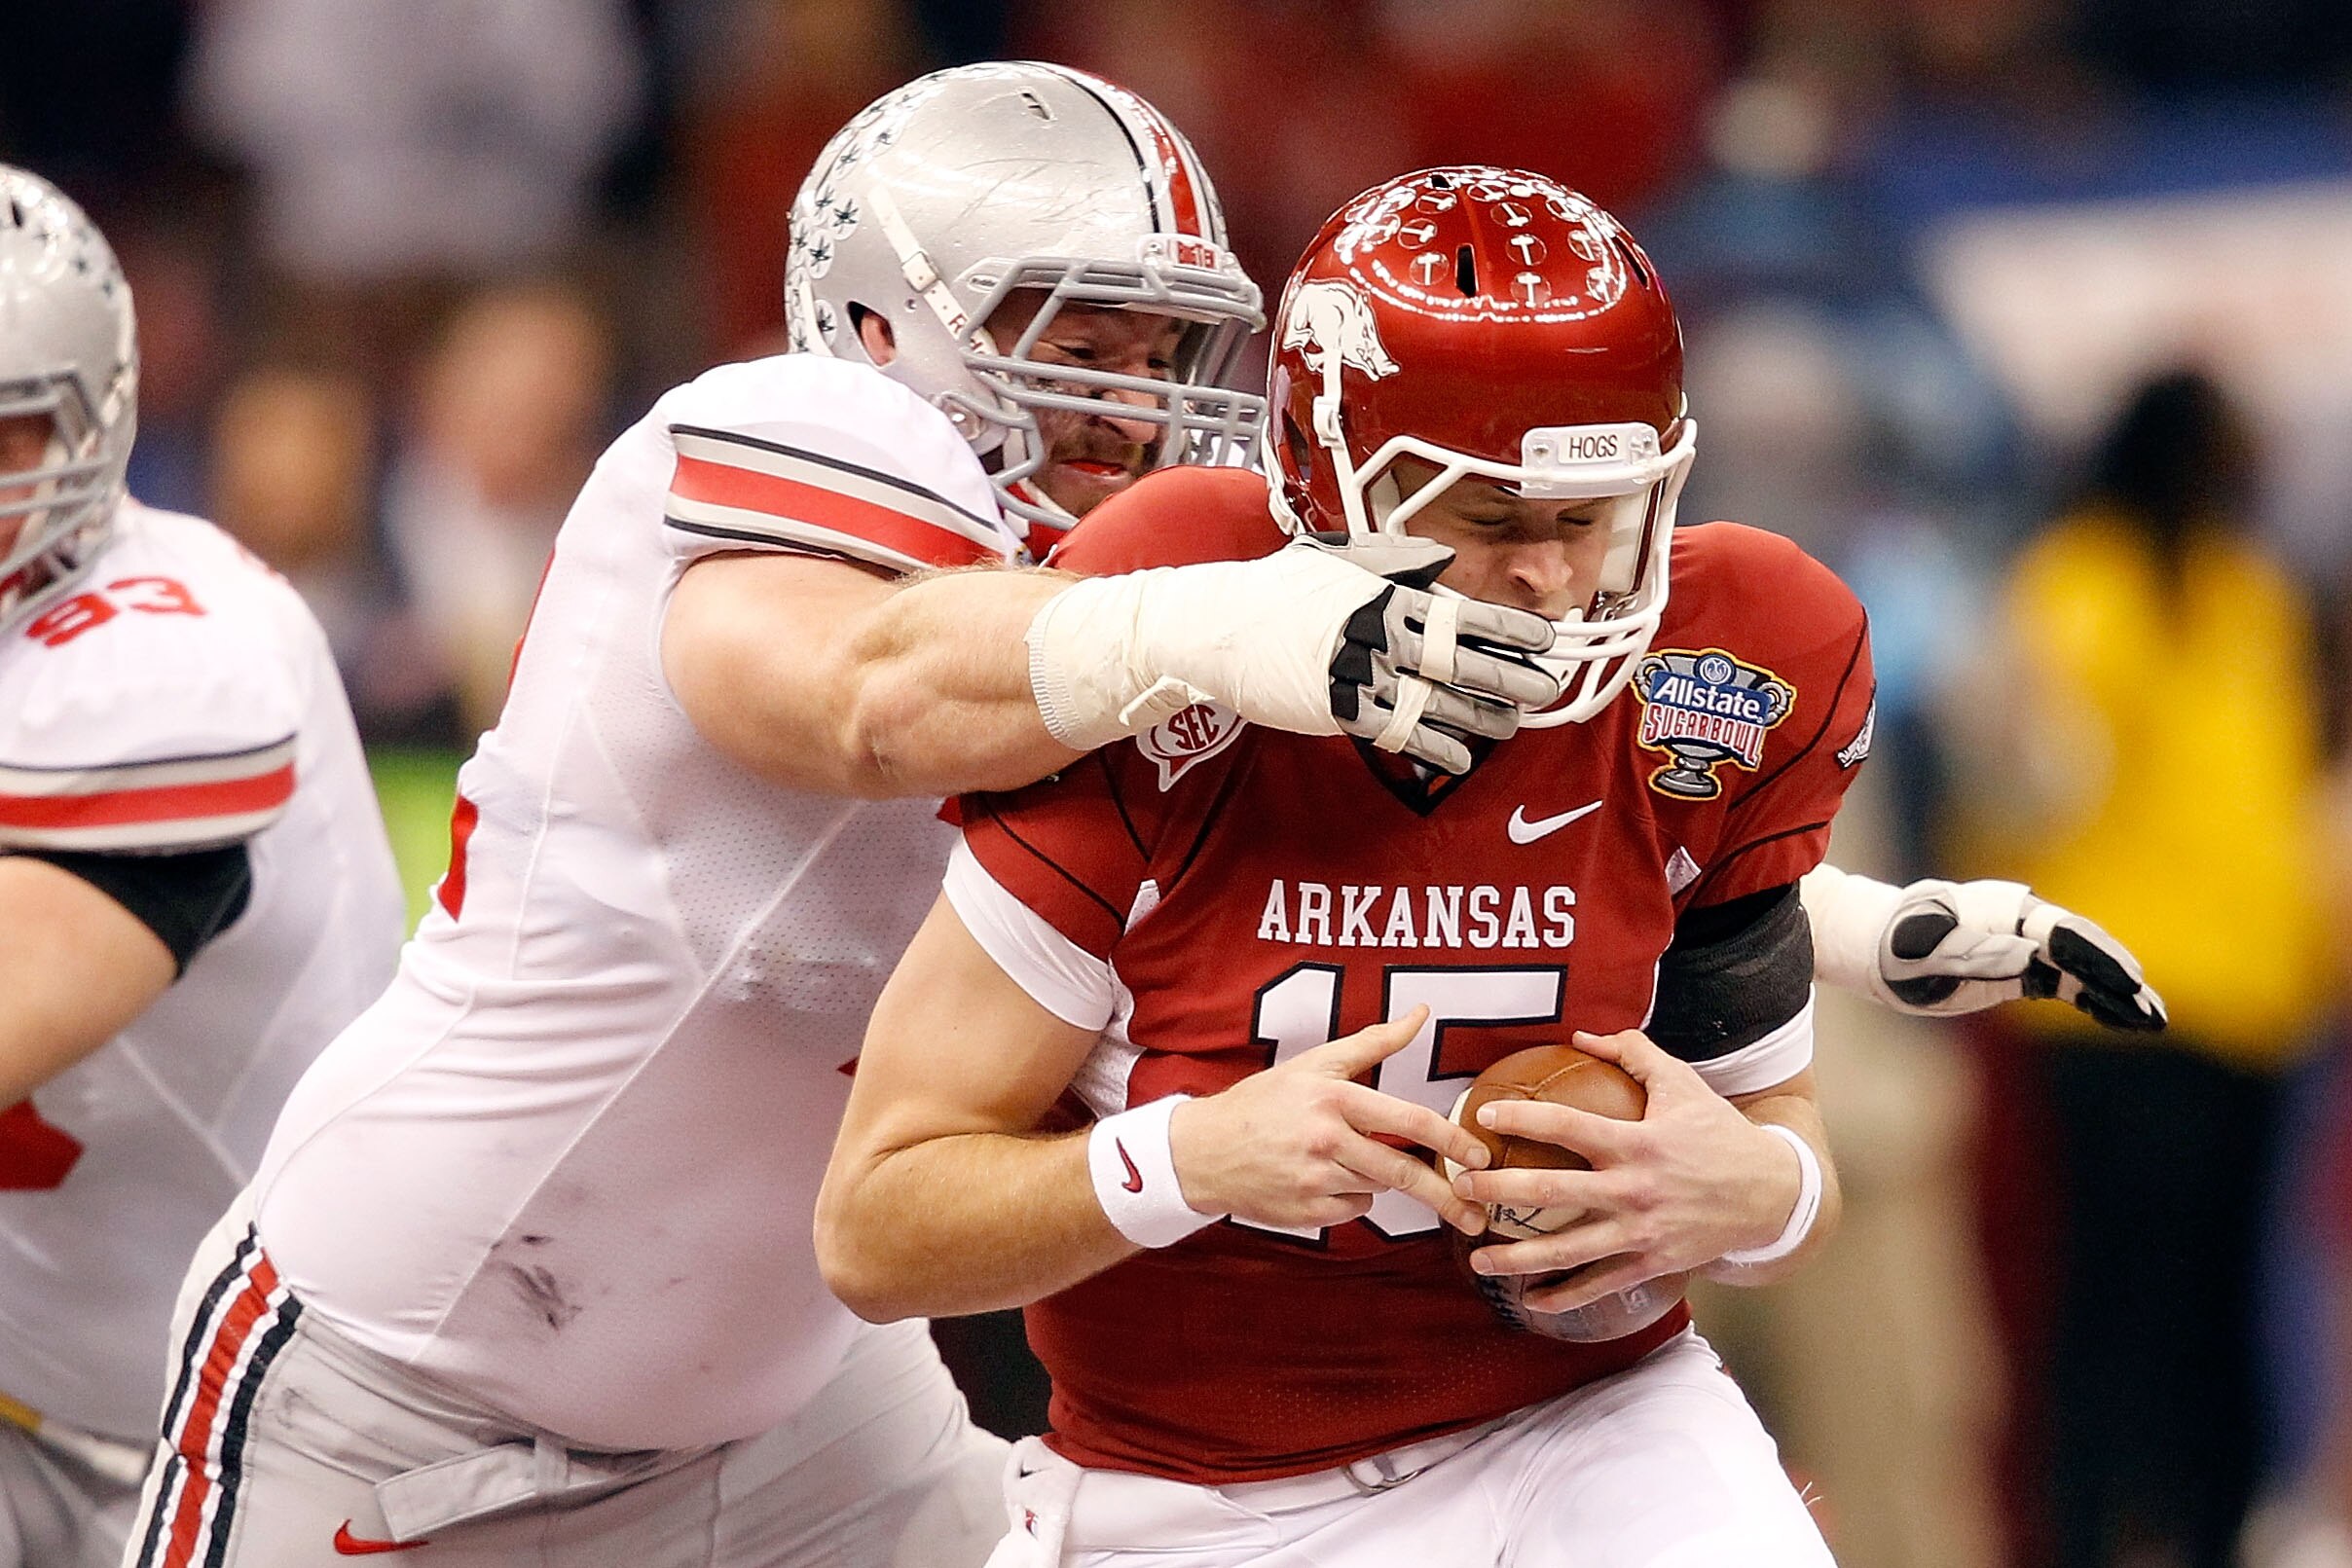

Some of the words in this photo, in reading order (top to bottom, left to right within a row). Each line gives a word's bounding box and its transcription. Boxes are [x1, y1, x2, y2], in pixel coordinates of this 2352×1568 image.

[1568, 434, 1619, 459] HOGS
[23, 575, 208, 650] 93
[1653, 675, 1764, 724] Allstate
[1168, 704, 1221, 750] SEC
[1257, 878, 1578, 949] ARKANSAS
